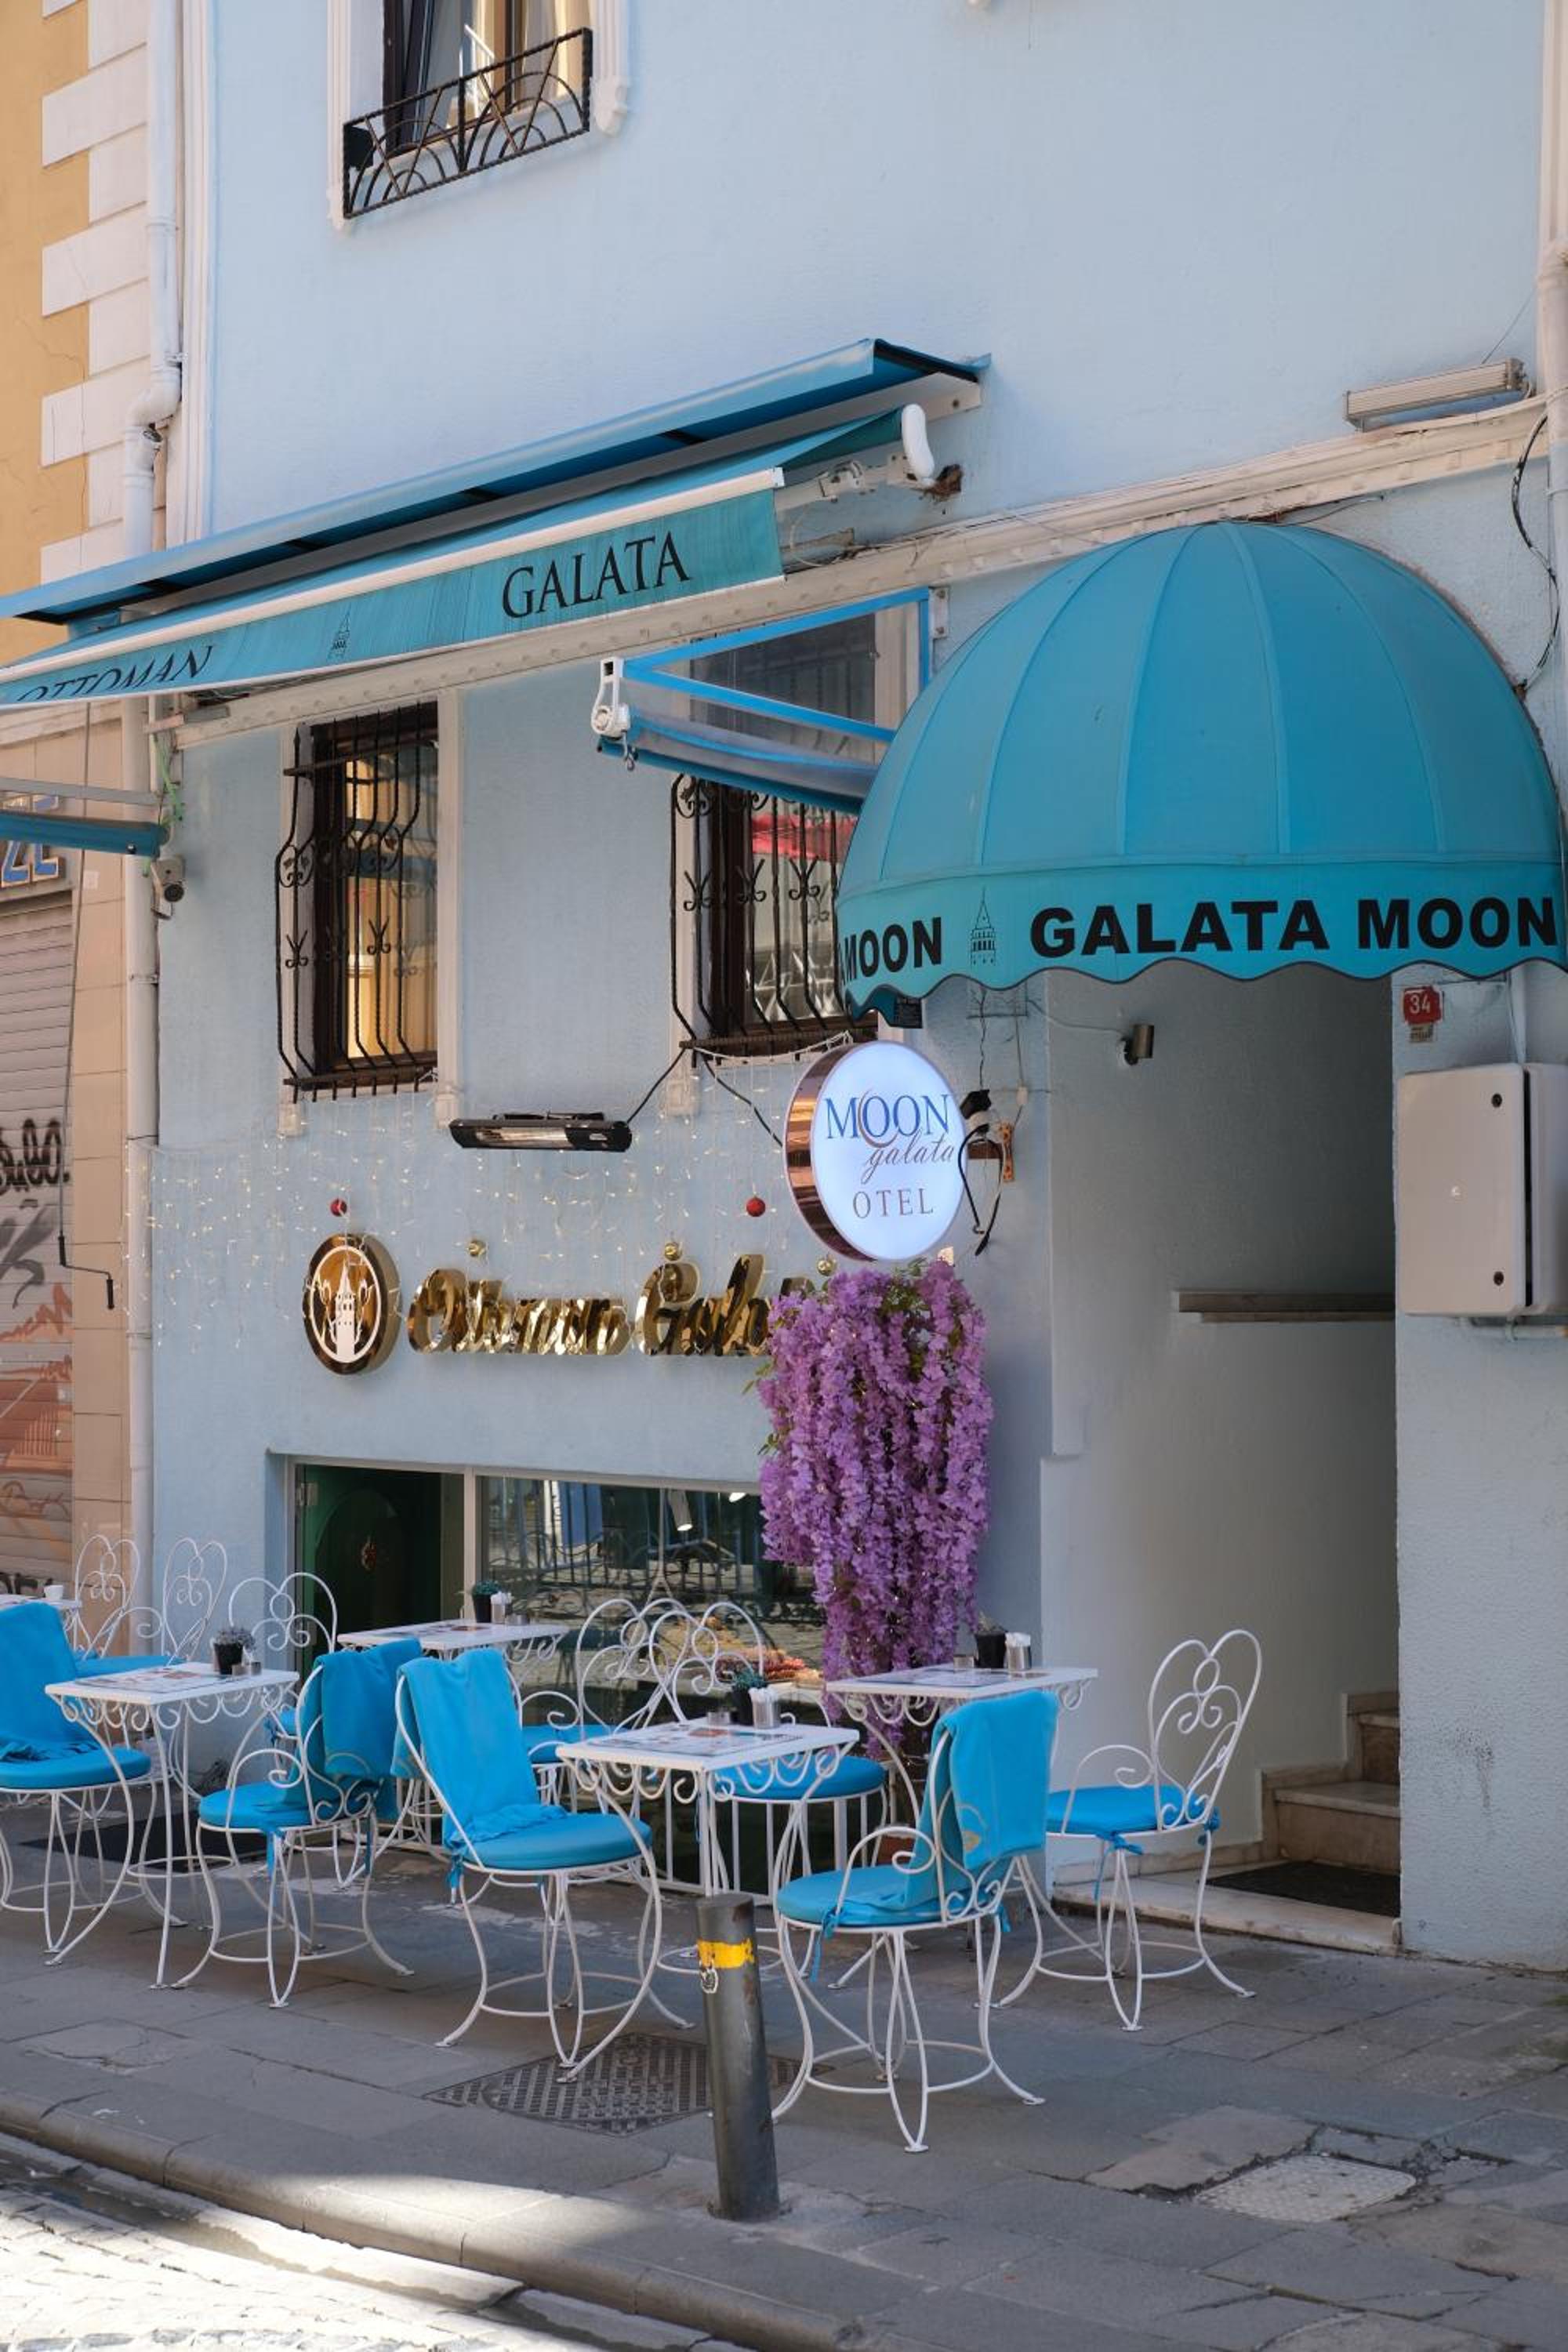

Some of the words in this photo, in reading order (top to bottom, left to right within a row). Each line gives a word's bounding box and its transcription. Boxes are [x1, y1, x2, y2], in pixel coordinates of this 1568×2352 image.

[503, 531, 692, 618] GALATA
[844, 916, 942, 982] MOON
[1030, 899, 1330, 958] GALATA
[1357, 897, 1557, 949] MOON
[1410, 993, 1431, 1014] 34
[825, 1094, 949, 1140] MOON
[861, 1128, 955, 1185] galata
[853, 1187, 934, 1218] OTEL
